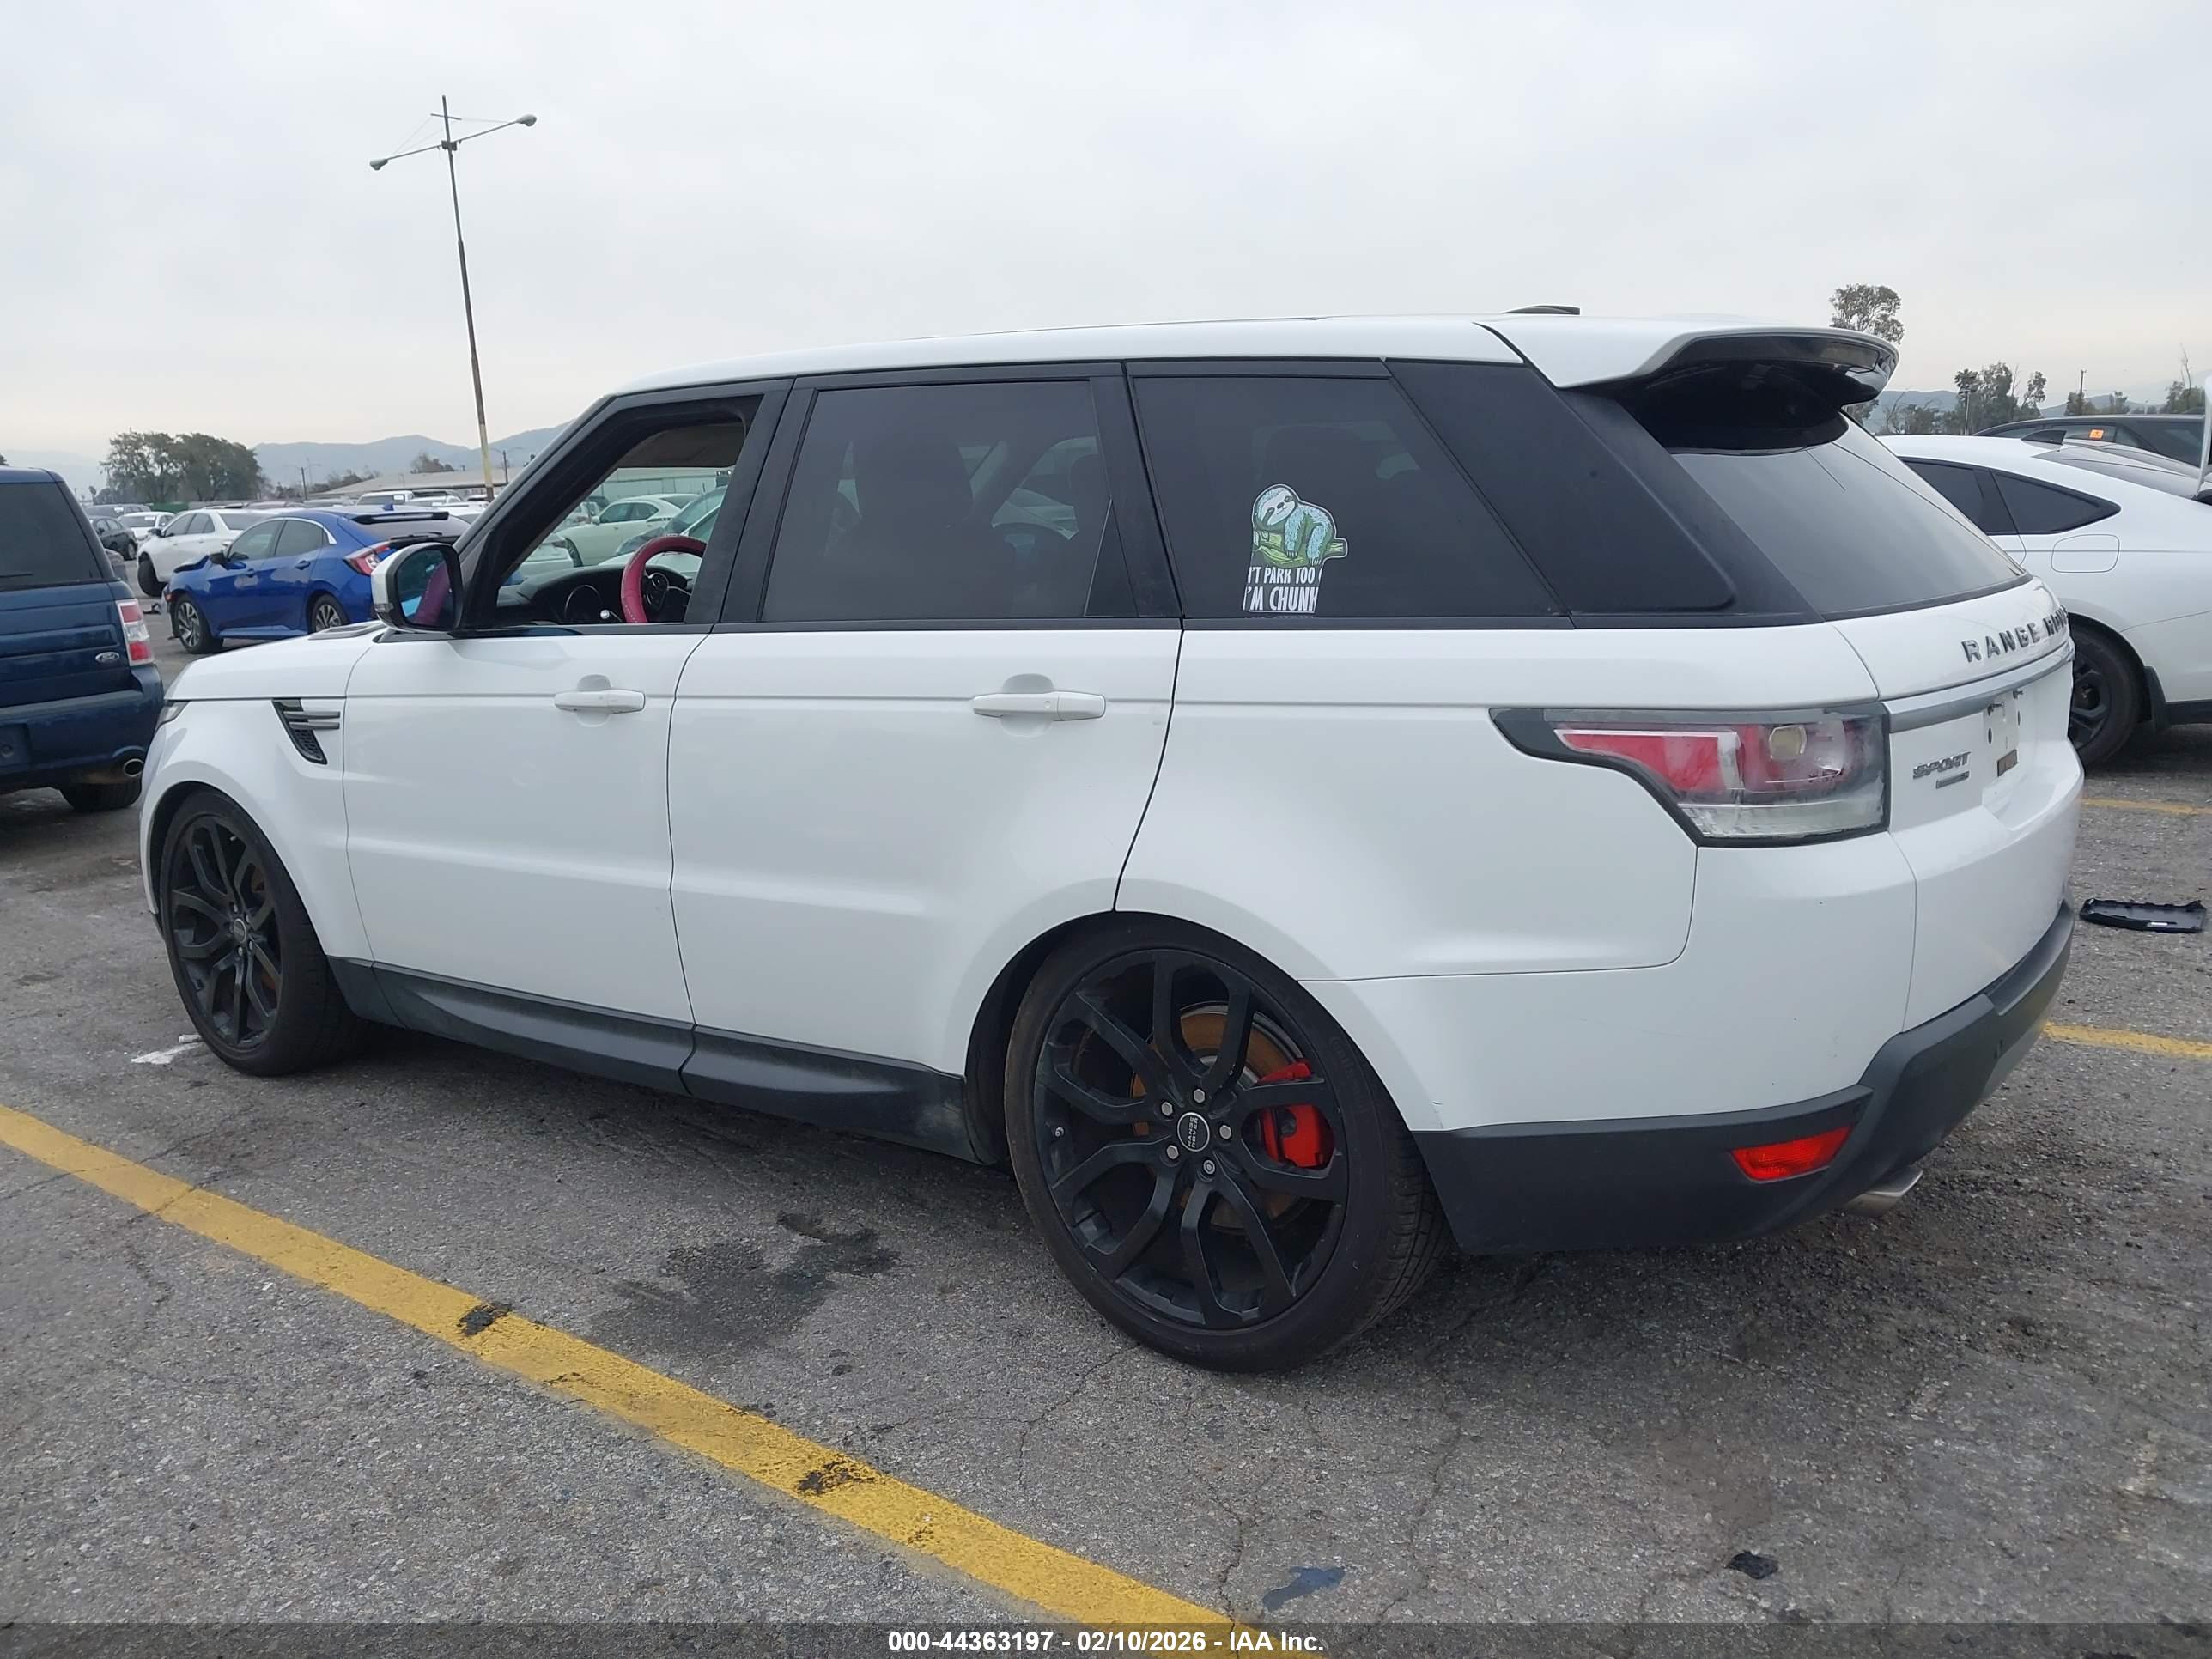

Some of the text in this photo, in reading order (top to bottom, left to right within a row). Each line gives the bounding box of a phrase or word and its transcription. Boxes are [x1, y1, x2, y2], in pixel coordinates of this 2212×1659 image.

[1263, 567, 1292, 584] PARK
[1295, 567, 1315, 584] TOO
[1961, 622, 2040, 663] RANGE
[1913, 751, 1972, 780] SPORT
